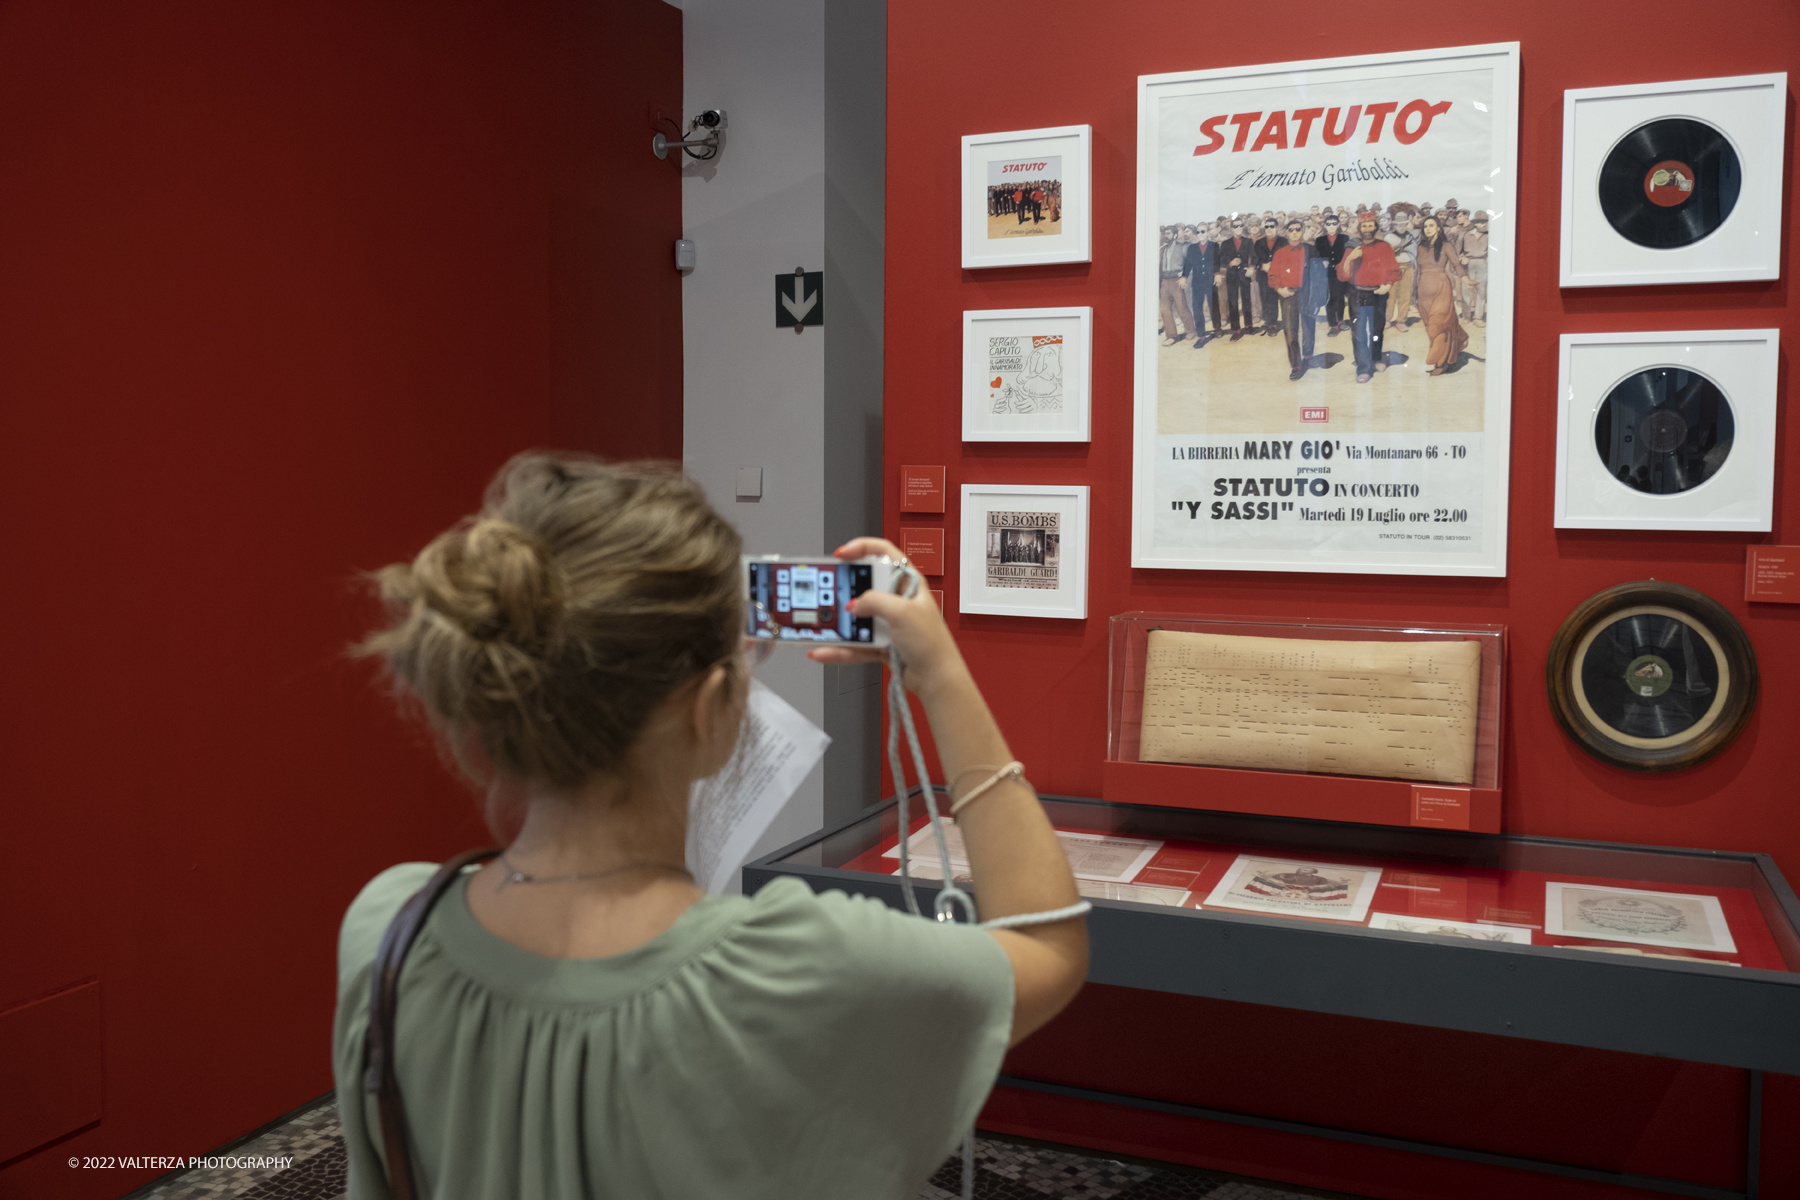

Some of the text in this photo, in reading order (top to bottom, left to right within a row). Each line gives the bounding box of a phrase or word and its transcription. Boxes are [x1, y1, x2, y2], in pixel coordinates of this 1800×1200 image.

[1193, 99, 1453, 156] STATUTO
[1002, 162, 1047, 173] STATUTO
[1250, 168, 1316, 188] tornato
[1322, 158, 1409, 191] Garibaldi
[989, 337, 1019, 347] SERGIO
[989, 346, 1021, 356] CAPUTO
[995, 357, 1021, 365] GARIBALDI
[1304, 411, 1324, 419] EMI
[1172, 447, 1185, 460] LA
[1188, 446, 1240, 460] BIRRERIA
[1243, 441, 1293, 460] MARY
[1300, 440, 1341, 460] GIO'
[1346, 445, 1362, 459] Via
[1365, 445, 1422, 459] Montanaro
[1425, 445, 1438, 459] 66
[1451, 445, 1467, 459] TO
[1297, 466, 1331, 476] presenta
[1213, 478, 1419, 497] STATUTO IN CONCERTO
[1211, 501, 1294, 520] SASSI"
[1299, 507, 1346, 521] Martedì
[1350, 508, 1364, 521] 19
[1367, 508, 1406, 525] Luglio
[1409, 511, 1430, 522] ore
[1433, 508, 1468, 522] 22.00
[1012, 515, 1057, 527] BOMBS
[988, 566, 1058, 578] GARIBALDI GUARD!
